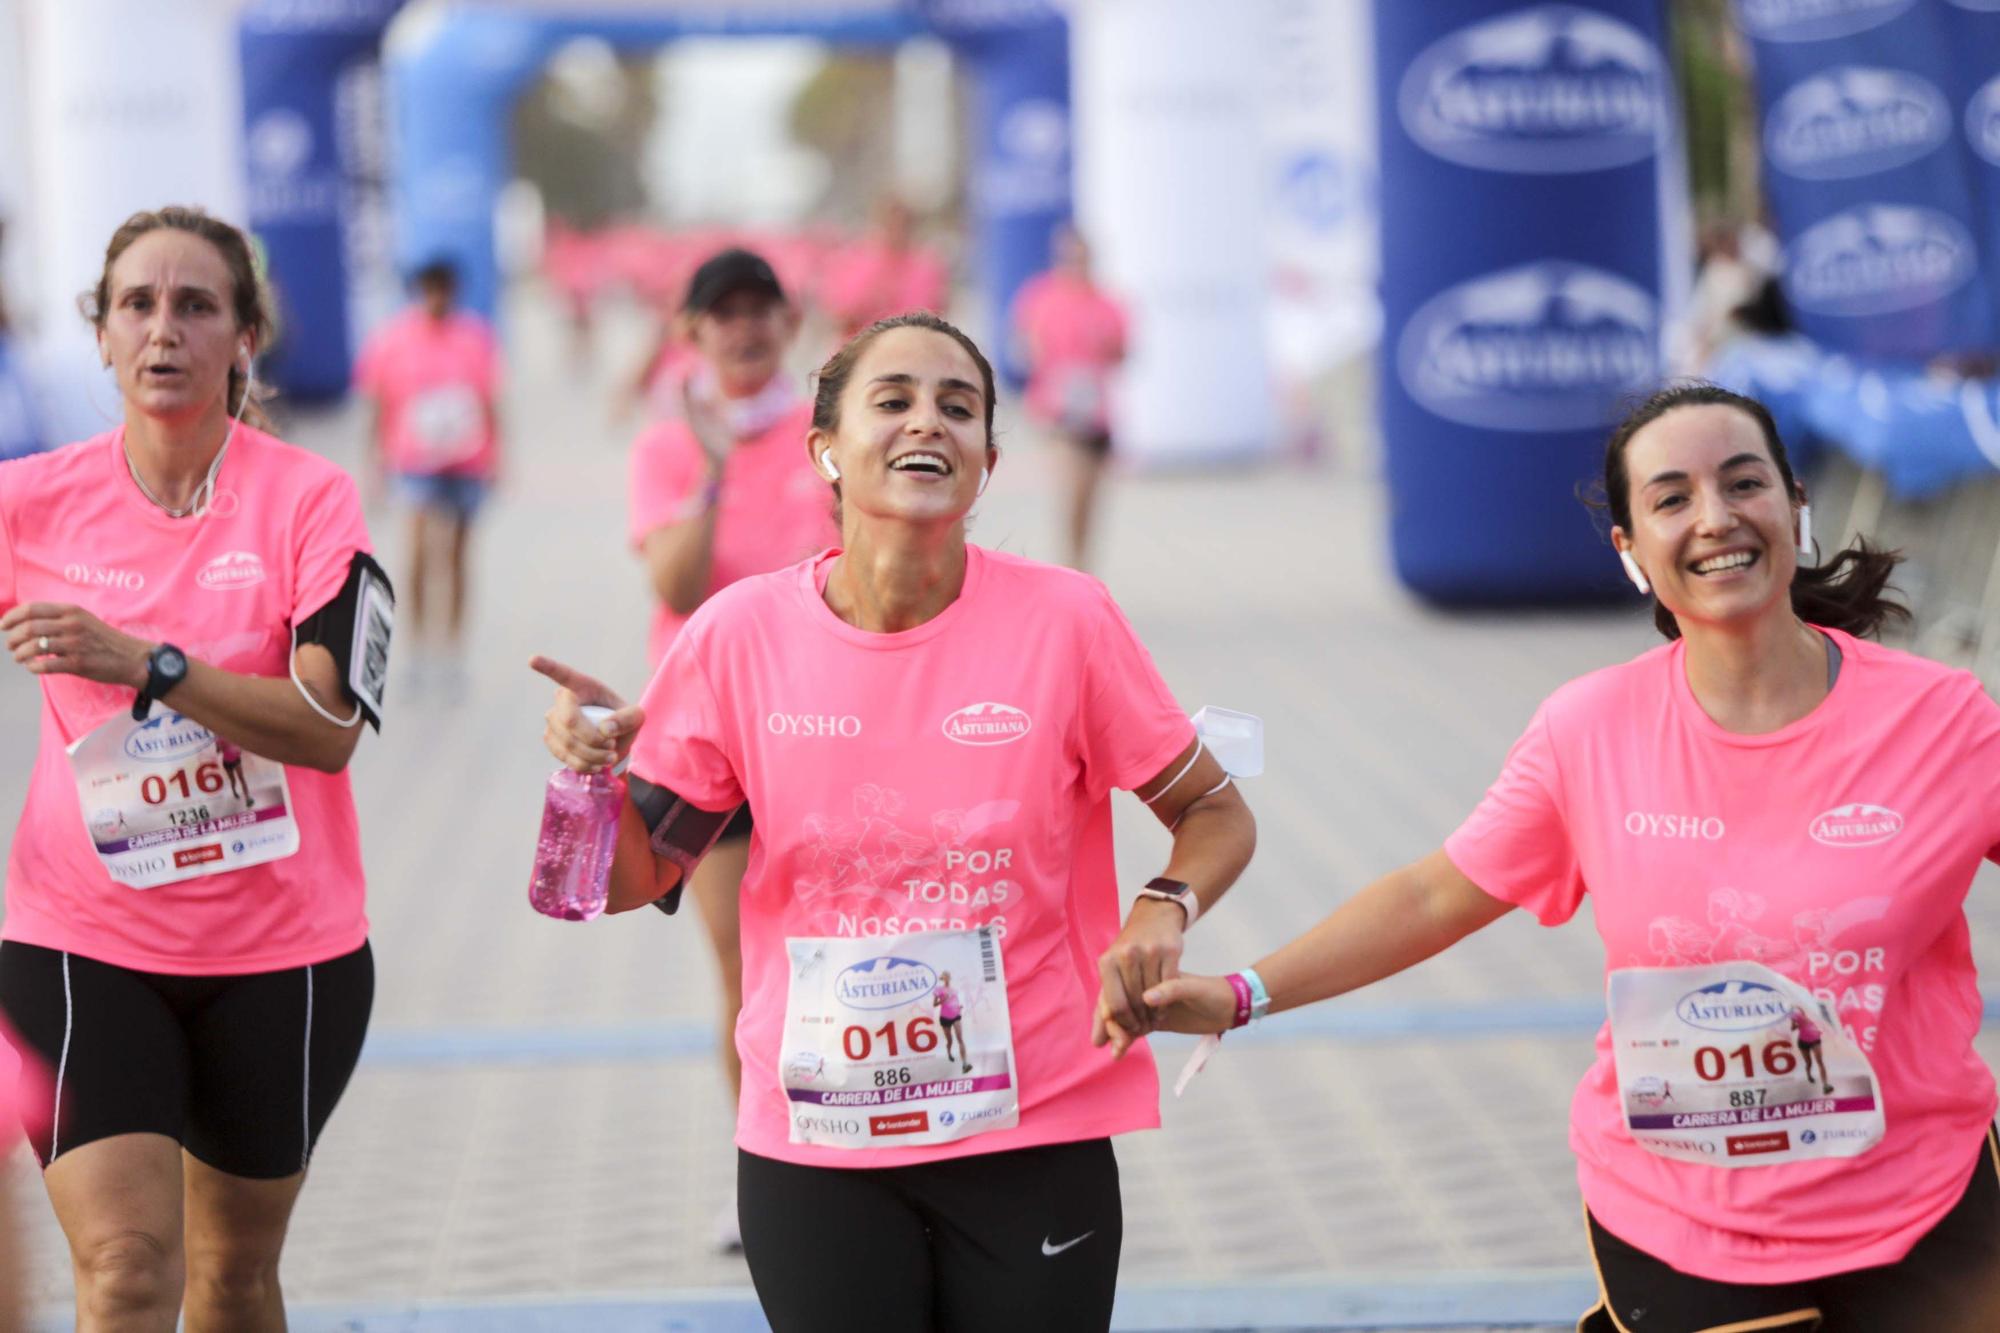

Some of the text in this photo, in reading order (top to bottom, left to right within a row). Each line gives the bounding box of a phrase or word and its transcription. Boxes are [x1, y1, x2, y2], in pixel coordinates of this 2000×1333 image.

[64, 562, 145, 592] OYSHO
[767, 712, 862, 737] OYSHO
[950, 719, 1025, 737] ASTURIANA
[133, 727, 211, 754] ASTURIANA
[141, 762, 224, 805] 016
[168, 805, 210, 826] 1236
[1625, 811, 1725, 840] OYSHO
[1816, 818, 1898, 839] ASTURIANA
[127, 811, 257, 850] CARRERA DE LA MUJER
[946, 848, 1012, 874] POR
[903, 879, 1008, 907] TODAS
[837, 912, 1007, 940] NOSOTRS
[1808, 947, 1884, 977] POR
[841, 976, 929, 998] ASTURIANA
[1686, 1001, 1787, 1020] ASTURIANA
[842, 1016, 938, 1061] 016
[1694, 1041, 1797, 1081] 016
[874, 1067, 911, 1087] 886
[821, 1079, 974, 1106] CARRERA DE LA MUJER
[1730, 1089, 1767, 1107] 887
[797, 1115, 860, 1135] OYSHO
[961, 1107, 1003, 1121] ZURICH
[1672, 1099, 1836, 1128] CARRERA DE LA MUJER
